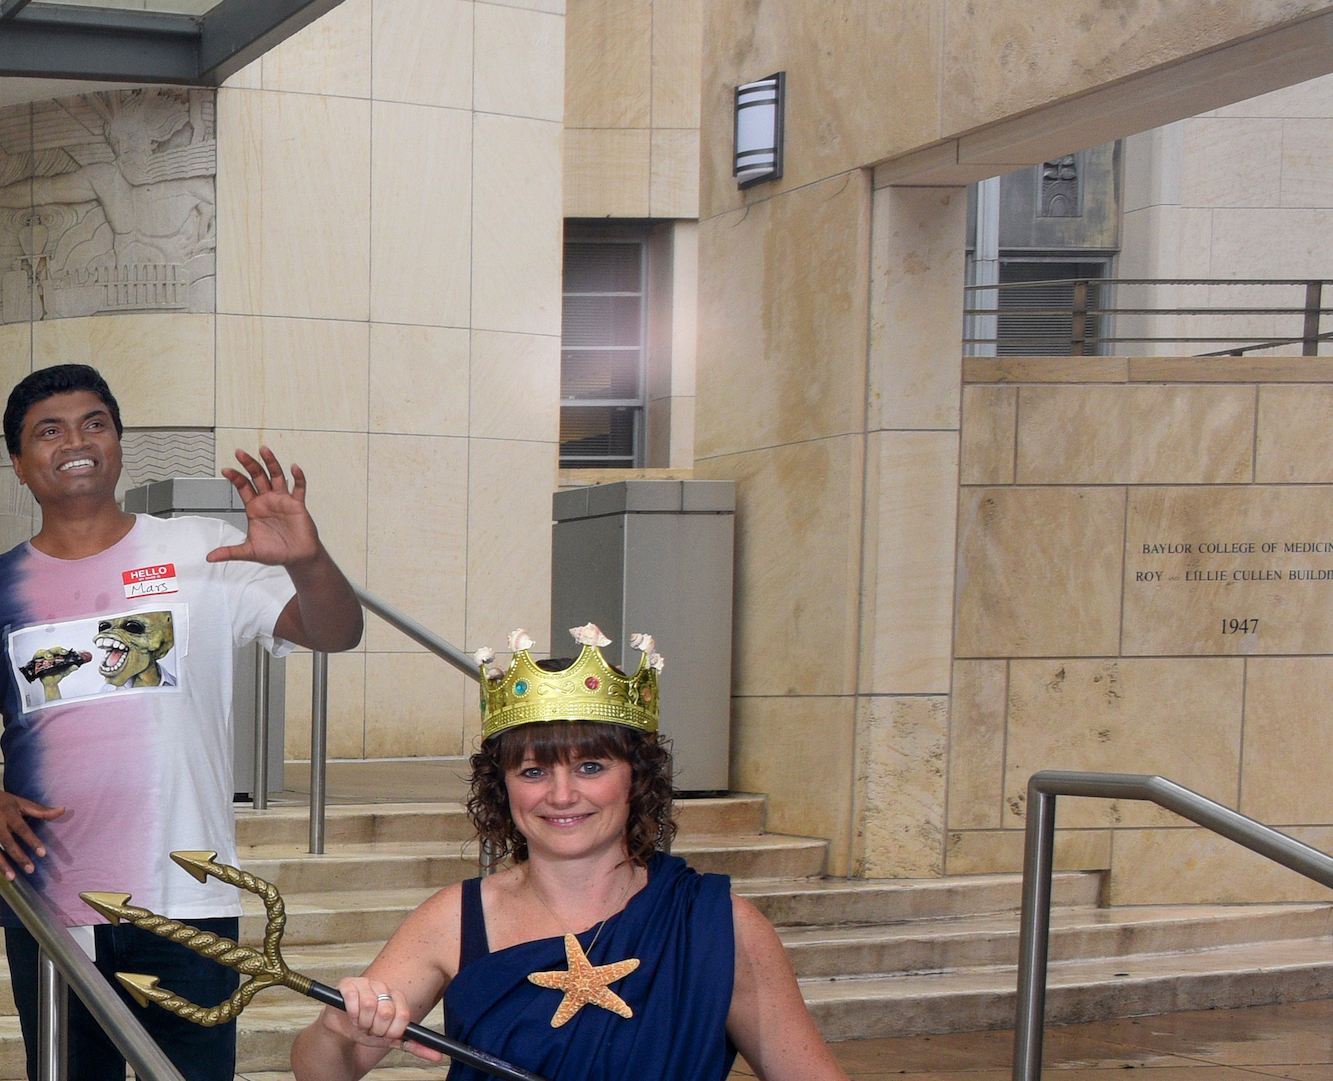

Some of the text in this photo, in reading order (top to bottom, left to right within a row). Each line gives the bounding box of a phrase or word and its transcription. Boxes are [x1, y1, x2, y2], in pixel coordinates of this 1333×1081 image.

[1142, 543, 1192, 554] BAYLOR
[1198, 542, 1255, 554] COLLEGE
[1261, 542, 1277, 553] OF
[130, 566, 167, 580] HELLO
[1136, 570, 1164, 582] ROY
[1185, 570, 1228, 581] LILLIE
[1233, 570, 1282, 581] CULLEN
[1289, 570, 1333, 581] BUILDI
[131, 582, 168, 595] Mars
[1221, 618, 1259, 635] 1947
